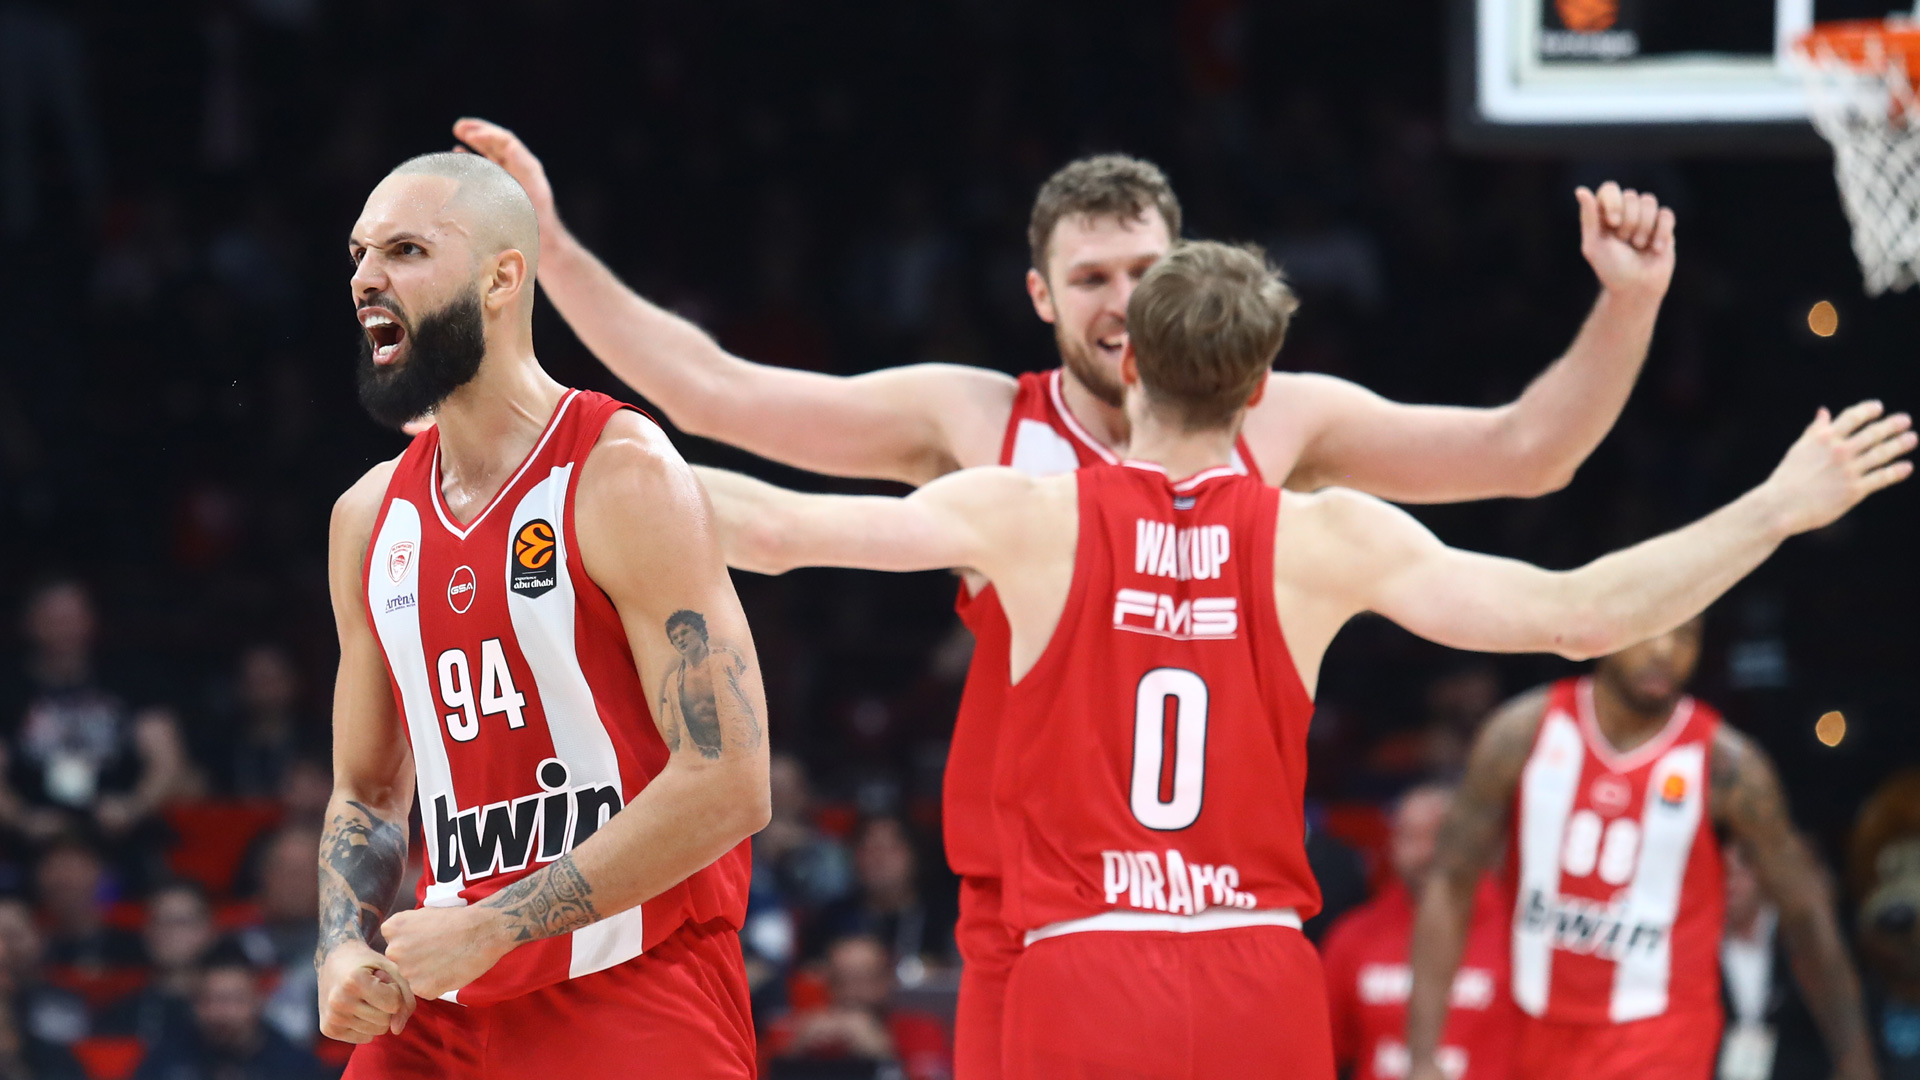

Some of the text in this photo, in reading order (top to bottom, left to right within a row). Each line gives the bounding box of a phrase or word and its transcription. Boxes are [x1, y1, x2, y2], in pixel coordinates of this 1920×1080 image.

[450, 581, 474, 595] GSA
[513, 577, 554, 589] abu dhabi
[1113, 588, 1238, 636] FMS
[437, 637, 526, 742] 94
[1130, 667, 1209, 831] 0
[430, 757, 627, 885] bwin
[1521, 884, 1664, 958] bwin
